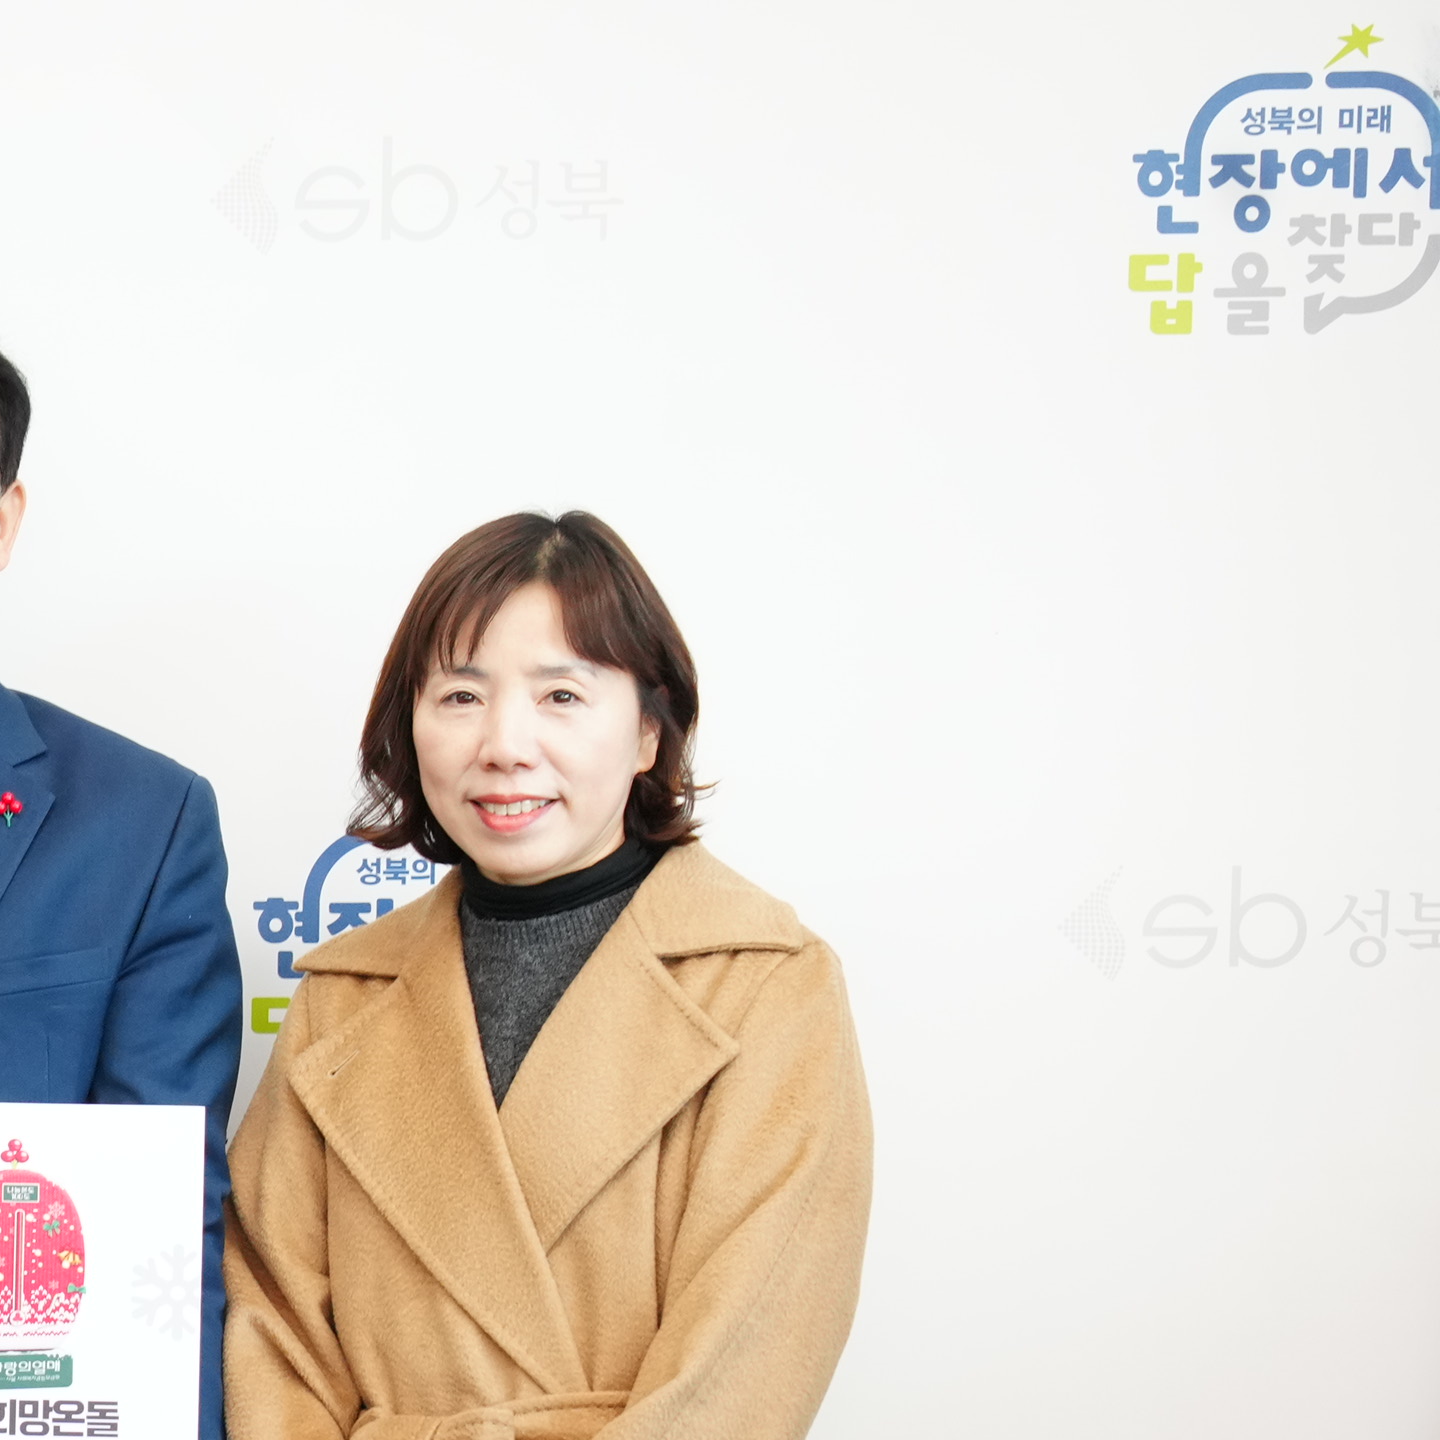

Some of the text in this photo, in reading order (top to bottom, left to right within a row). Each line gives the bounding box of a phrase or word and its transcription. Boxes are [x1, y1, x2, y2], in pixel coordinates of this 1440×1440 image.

[1240, 105, 1392, 135] 성북의 미래
[475, 159, 624, 242] 성북
[1133, 147, 1440, 234] 현장에서
[1128, 212, 1421, 335] 답을 찾다
[357, 857, 436, 885] 성북의
[1142, 865, 1307, 969] sb
